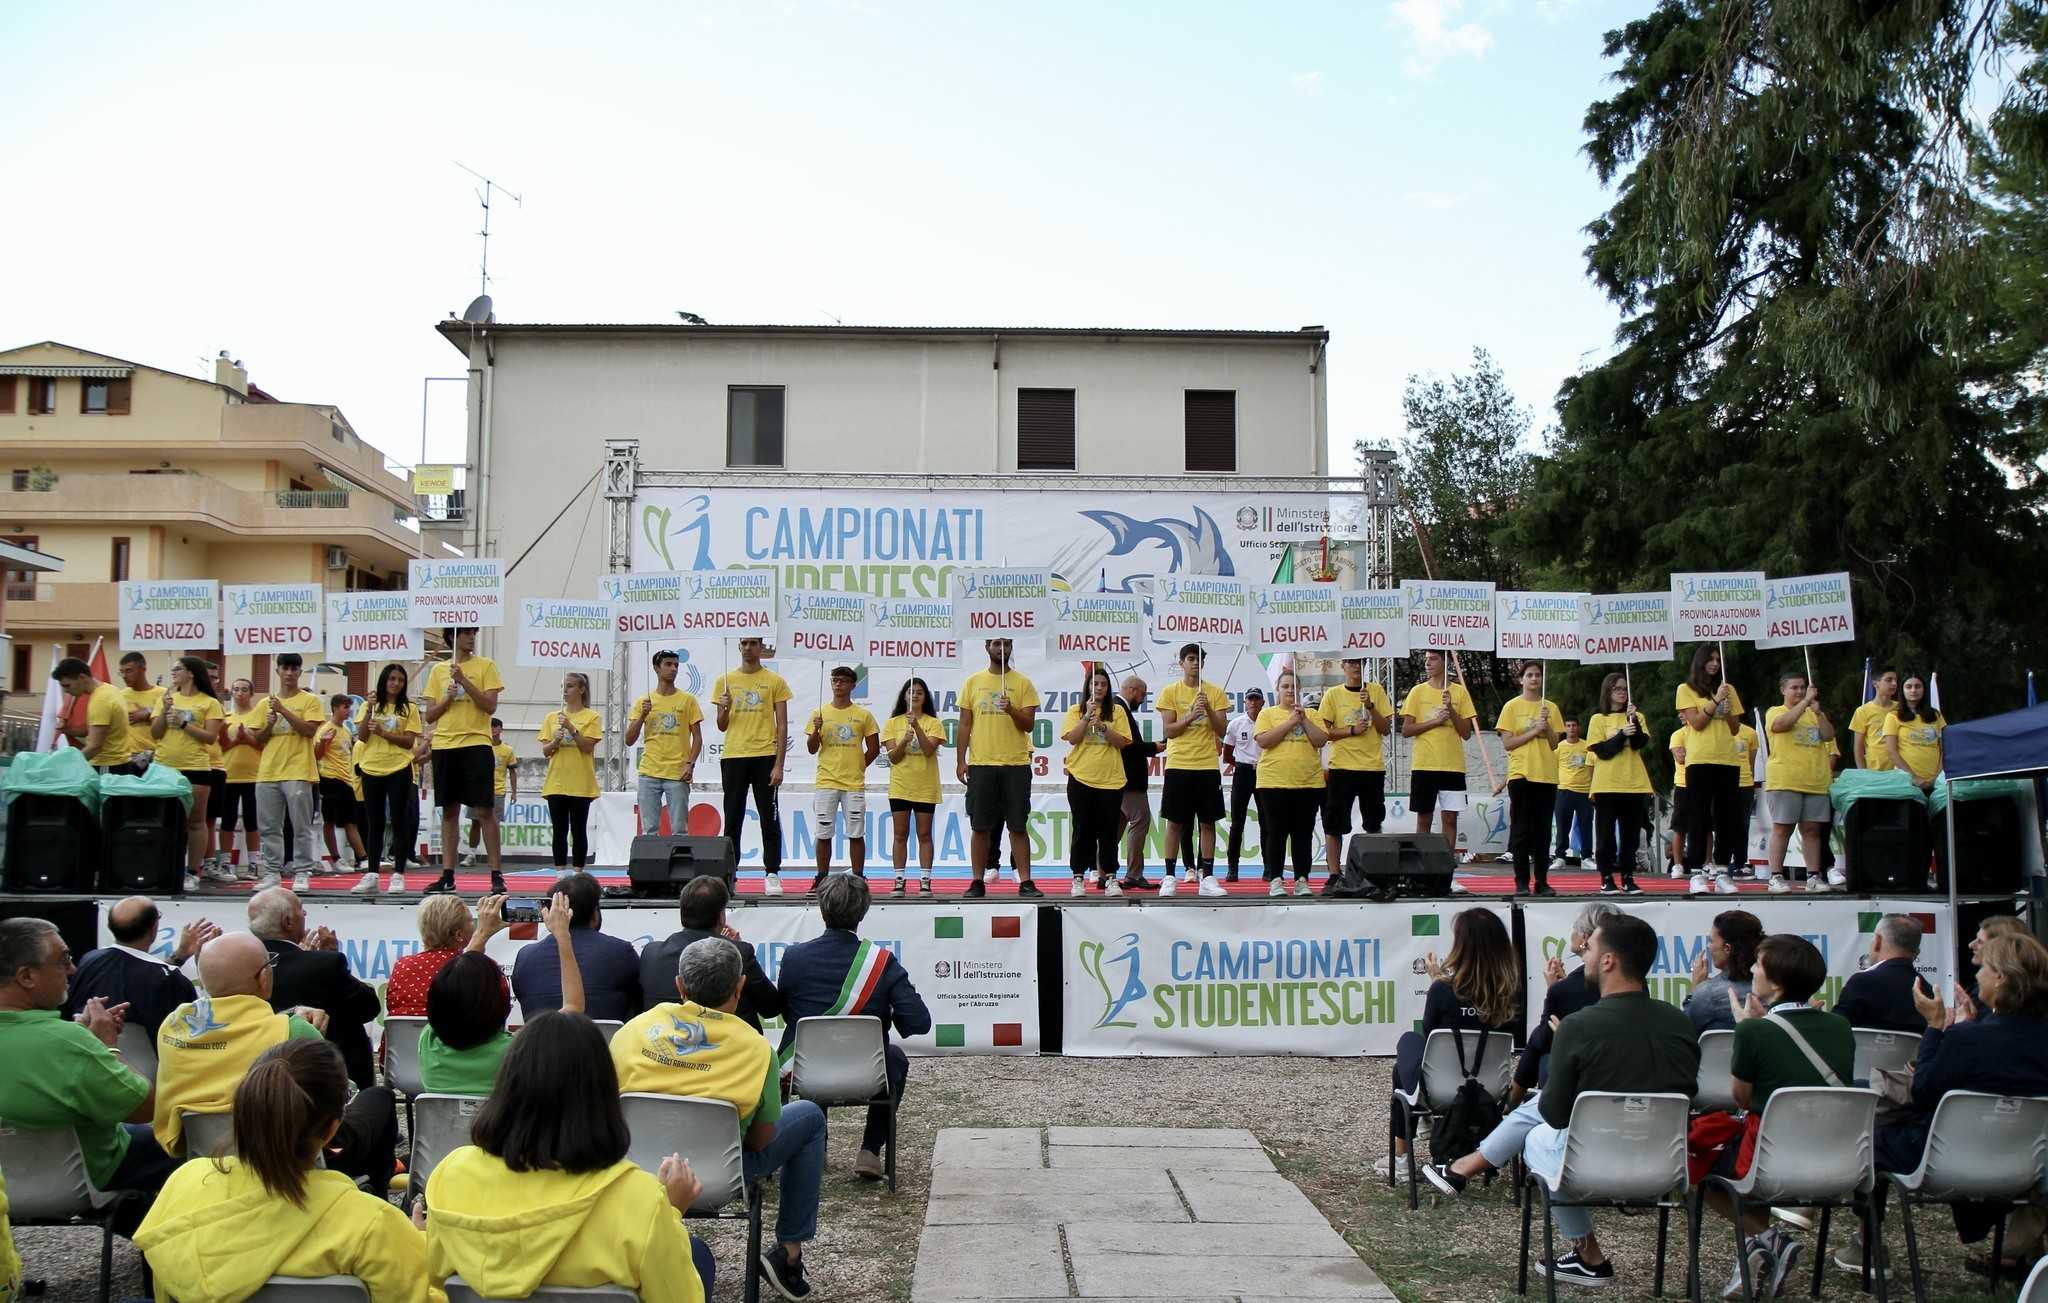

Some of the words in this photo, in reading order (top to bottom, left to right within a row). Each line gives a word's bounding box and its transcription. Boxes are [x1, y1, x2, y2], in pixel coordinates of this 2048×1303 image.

[746, 507, 983, 560] CAMPIONATI
[438, 564, 496, 576] CAMPIONATI
[433, 575, 500, 588] STUDENTESCHI
[627, 577, 680, 590] CAMPIONAT
[709, 575, 766, 588] CAMPIONATI
[983, 574, 1042, 586] CAMPIONATI
[1184, 580, 1241, 594] CAMPIONATI
[1701, 578, 1757, 590] CAMPIONATI
[1782, 579, 1841, 595] CAMPIONATI
[150, 586, 208, 598] CAMPIONATI
[254, 591, 312, 602] CAMPIONATI
[623, 589, 680, 603] STUDENTESC
[704, 586, 770, 600] STUDENTESCHI
[978, 586, 1046, 599] STUDENTESCHI
[1179, 592, 1245, 606] STUDENTESCHI
[1274, 589, 1331, 601] CAMPIONATI
[1430, 587, 1487, 599] CAMPIONATI
[1696, 589, 1760, 602] STUDENTESCHI
[144, 598, 213, 611] STUDENTESCHI
[357, 599, 407, 610] CAMPIONA
[415, 596, 454, 606] PROVINCIA
[456, 595, 498, 605] AUTONOMA
[1077, 600, 1135, 611] CAMPIONATI
[1270, 600, 1336, 614] STUDENTESCHI
[1425, 599, 1490, 612] STUDENTESCHI
[1608, 600, 1664, 612] CAMPIONATI
[1778, 591, 1846, 609] STUDENTESCHI
[248, 601, 316, 615] STUDENTESCHI
[550, 605, 608, 617] CAMPIONATI
[1679, 609, 1719, 620] PROVINCIA
[1720, 608, 1760, 618] AUTONOMA
[352, 609, 408, 622] STUDENTESC
[433, 611, 478, 623] TRENTO
[683, 611, 770, 628] SARDEGNA
[970, 612, 1034, 628] MOLISE
[1071, 610, 1138, 624] STUDENTESCHI
[1443, 614, 1490, 629] VENEZIA
[1520, 609, 1578, 622] STUDENTESC
[1604, 610, 1668, 624] STUDENTESCHI
[544, 616, 611, 630] STUDENTESCHI
[619, 614, 676, 632] SICILIA
[1158, 615, 1244, 635] LOMBARDIA
[1767, 615, 1848, 637] ASILICATA
[133, 623, 205, 640] ABRUZZO
[234, 627, 312, 643] VENETO
[1261, 625, 1327, 643] LIGURIA
[1693, 624, 1747, 637] BOLZANO
[343, 634, 408, 651] UMBRIA
[793, 632, 854, 651] PUGLIA
[1059, 634, 1130, 651] MARCHE
[1343, 632, 1386, 649] AZIO
[1428, 632, 1466, 646] GIULIA
[1502, 632, 1532, 649] EMILIA
[1538, 633, 1580, 650] ROMAGN
[1585, 635, 1669, 654] CAMPANIA
[531, 640, 601, 658] TOSCANA
[869, 640, 956, 657] PIEMONTE
[964, 961, 1002, 969] Ministero
[1171, 938, 1381, 981] CAMPIONATI
[964, 970, 1021, 979] dell'Istruzione
[1153, 980, 1395, 1028] STUDENTESCHI
